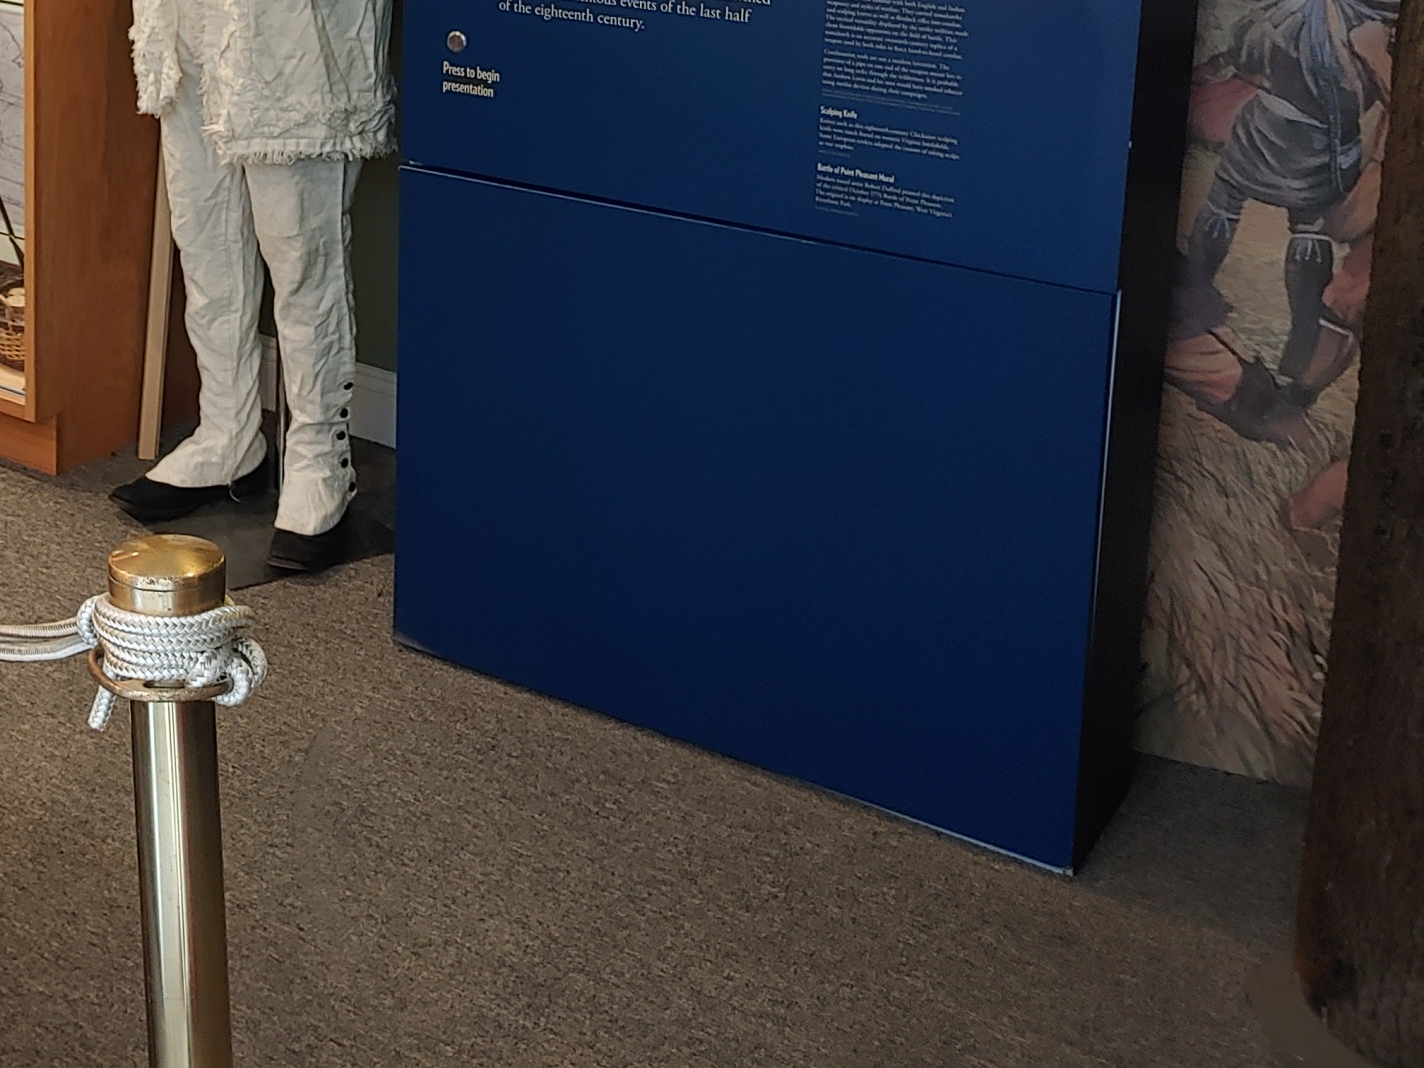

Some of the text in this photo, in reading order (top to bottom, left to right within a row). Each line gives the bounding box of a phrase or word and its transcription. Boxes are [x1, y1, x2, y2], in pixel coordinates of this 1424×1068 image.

[533, 2, 594, 22] eighteenth
[596, 14, 644, 32] century.
[676, 0, 696, 15] the
[699, 2, 721, 19] last
[723, 5, 752, 22] half
[443, 61, 500, 83] Press to begin
[442, 81, 494, 98] presentation
